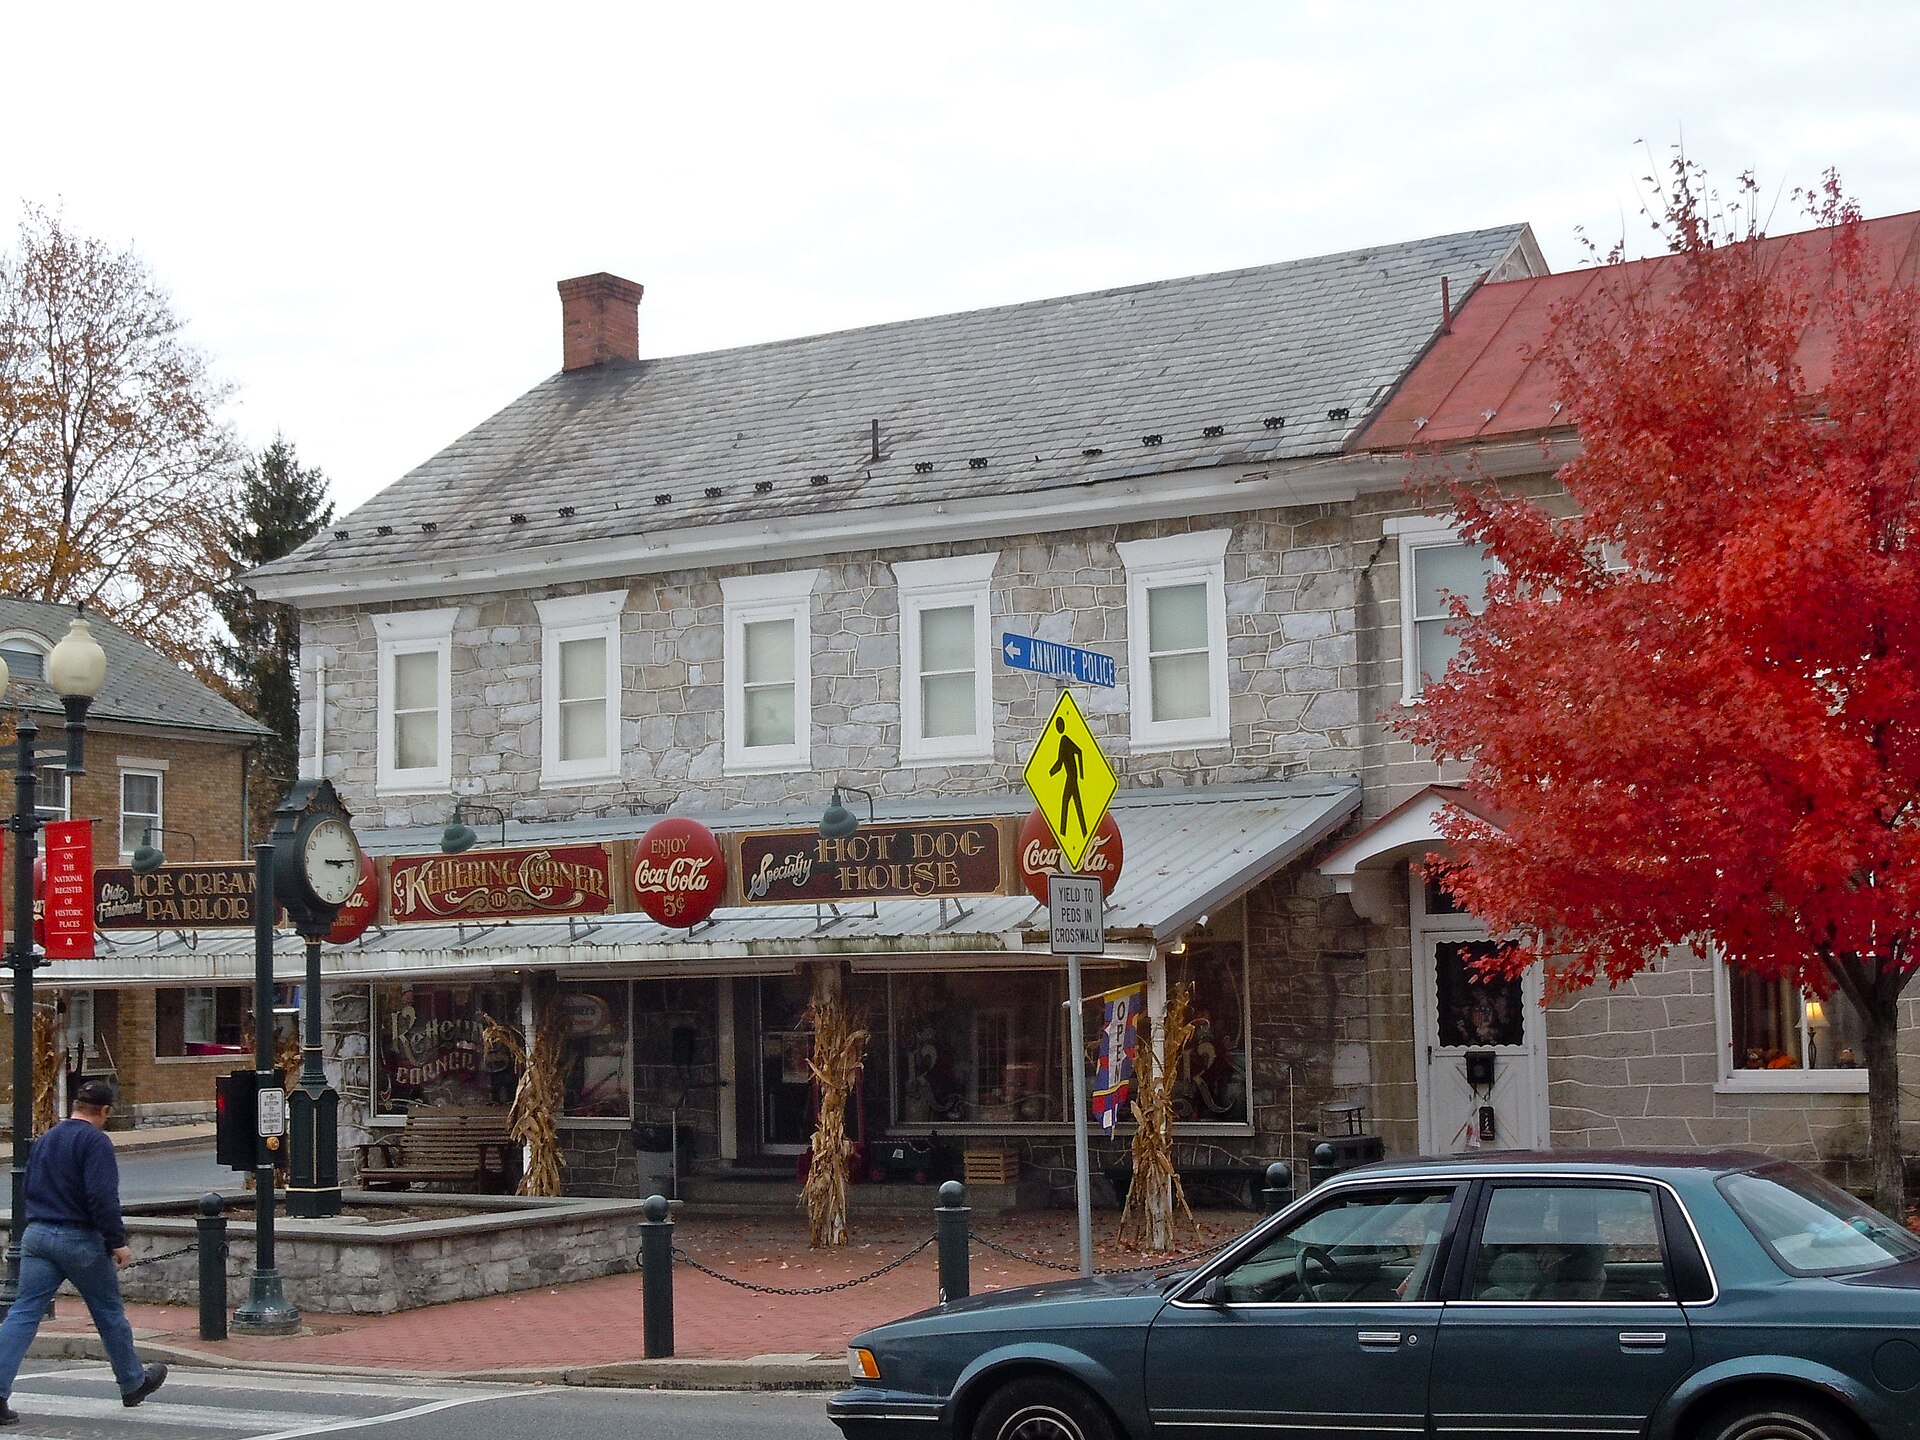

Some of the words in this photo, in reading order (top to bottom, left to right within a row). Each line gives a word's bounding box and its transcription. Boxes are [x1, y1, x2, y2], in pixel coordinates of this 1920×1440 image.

[1029, 640, 1077, 677] ANNVILLE
[1082, 652, 1115, 686] POLICE
[63, 852, 74, 860] ON
[650, 834, 691, 859] ENJOY
[813, 833, 897, 863] HOT
[911, 831, 985, 858] DOG
[54, 874, 84, 883] NATIONAL
[132, 874, 175, 897] ICE
[518, 850, 608, 901] CORNER
[634, 856, 714, 893] Coca-Cola
[748, 851, 813, 900] Specialty
[834, 861, 961, 895] HOUSE
[54, 886, 83, 894] REGISTER
[64, 897, 73, 905] OF
[101, 883, 129, 903] Olde
[1058, 887, 1081, 903] YIELD
[1084, 888, 1094, 903] TO
[55, 908, 84, 917] HISTORIC
[96, 898, 144, 922] Fashioned
[145, 897, 250, 921] PARLOR
[663, 893, 685, 917] 5¢
[1061, 907, 1081, 923] PEDS
[1085, 908, 1093, 923] IN
[59, 920, 81, 928] PLACES
[1055, 927, 1099, 944] CROSSWALK
[1114, 1001, 1126, 1084] OPEN
